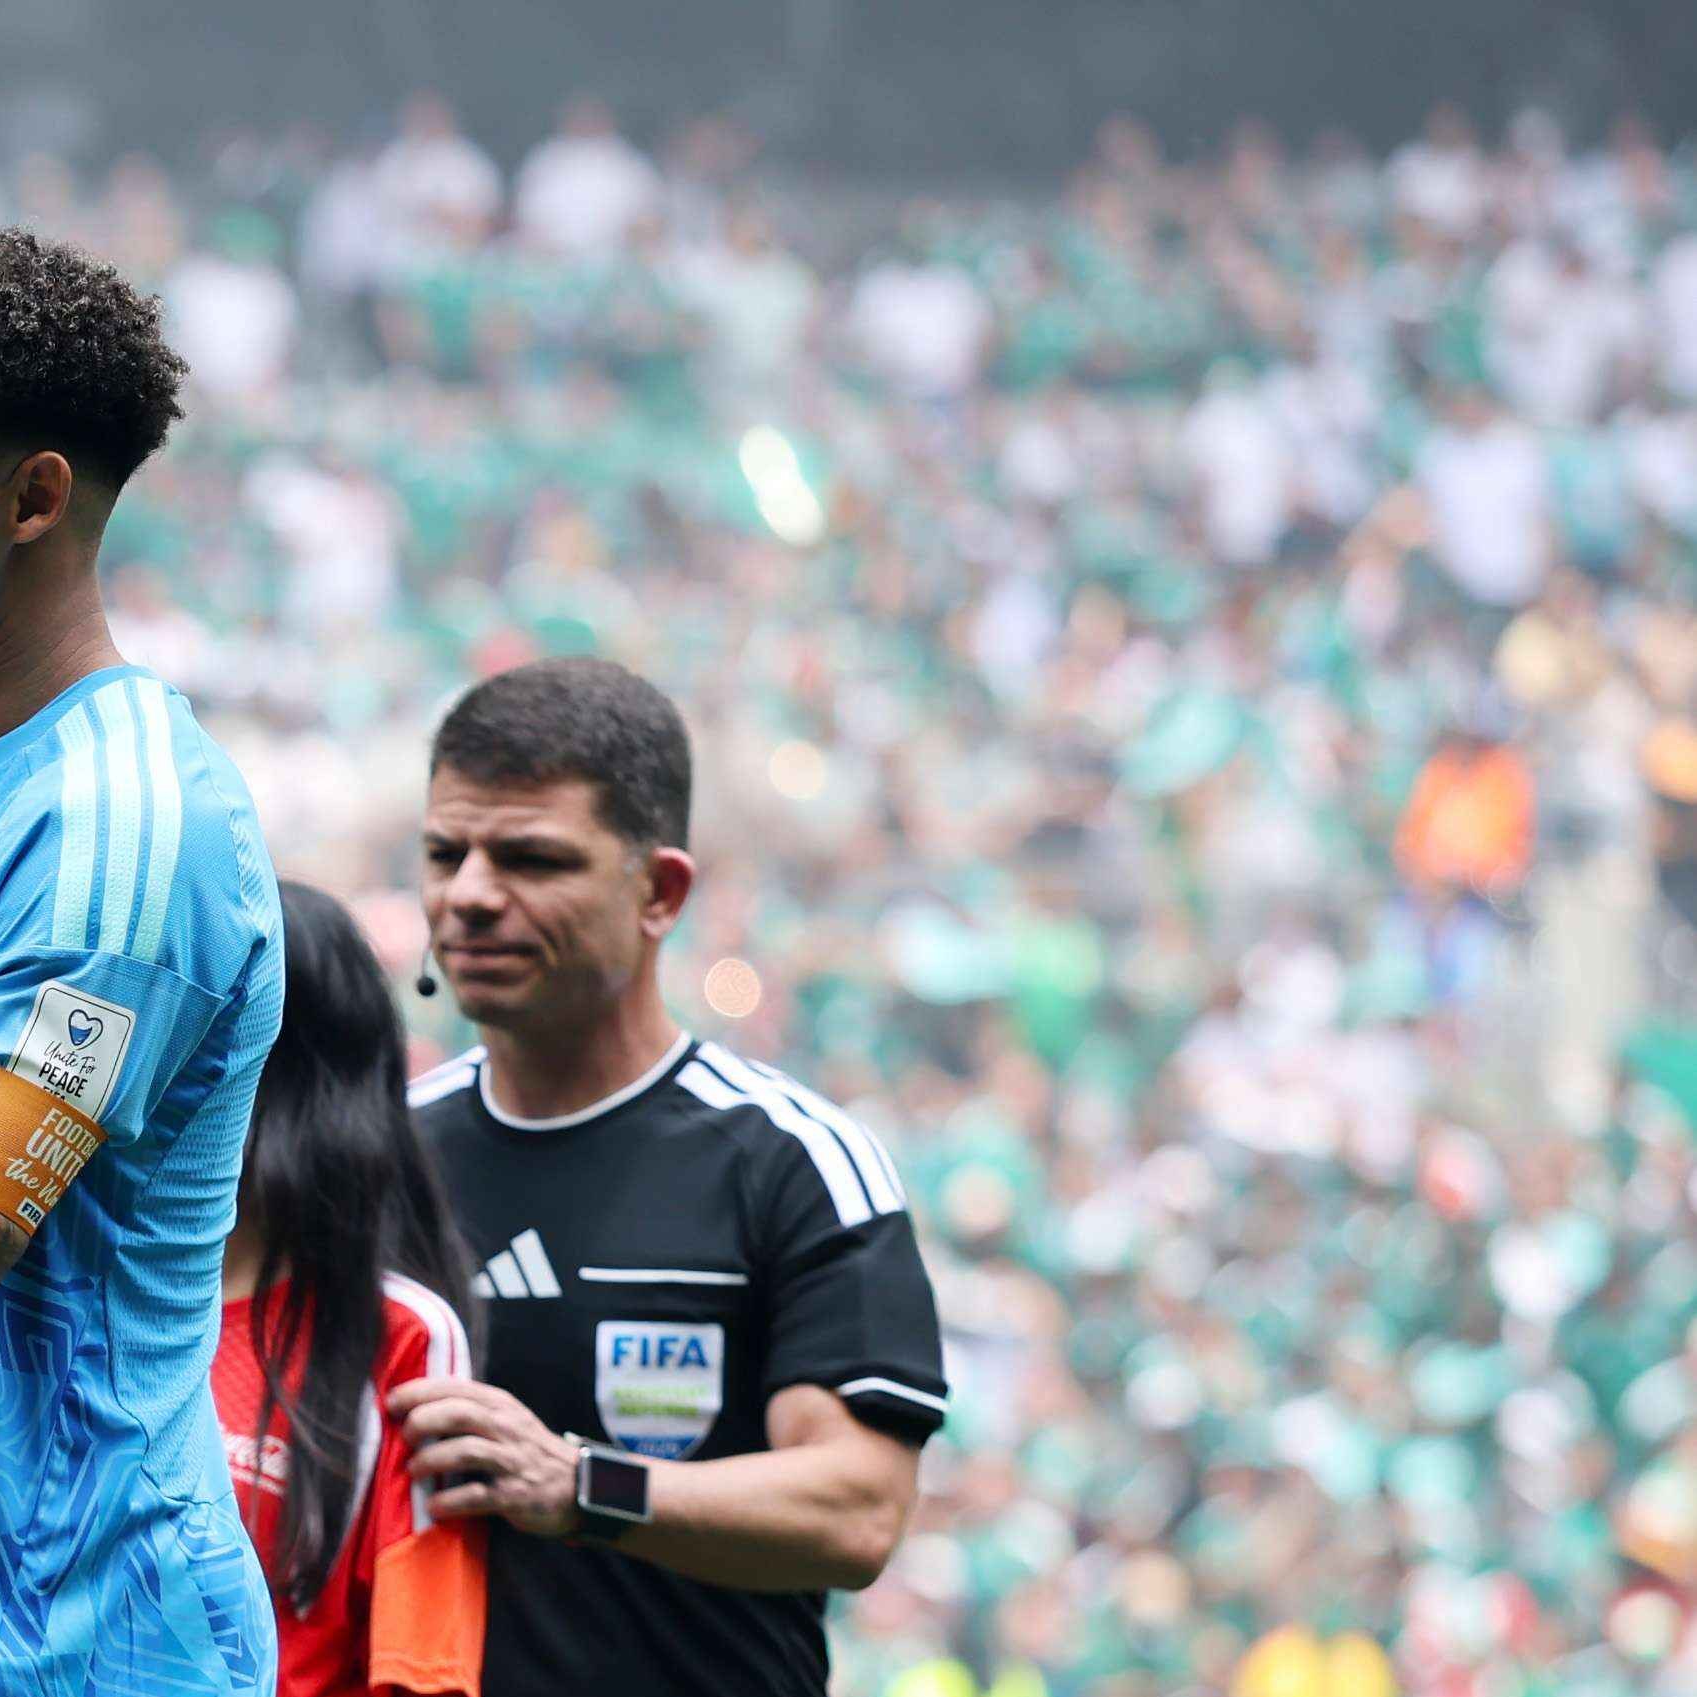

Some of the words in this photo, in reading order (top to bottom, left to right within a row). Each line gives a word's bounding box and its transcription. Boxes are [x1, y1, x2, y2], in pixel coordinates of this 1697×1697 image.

[44, 1040, 79, 1067] Unite
[38, 1061, 88, 1099] PEACE
[612, 1335, 709, 1369] FIFA
